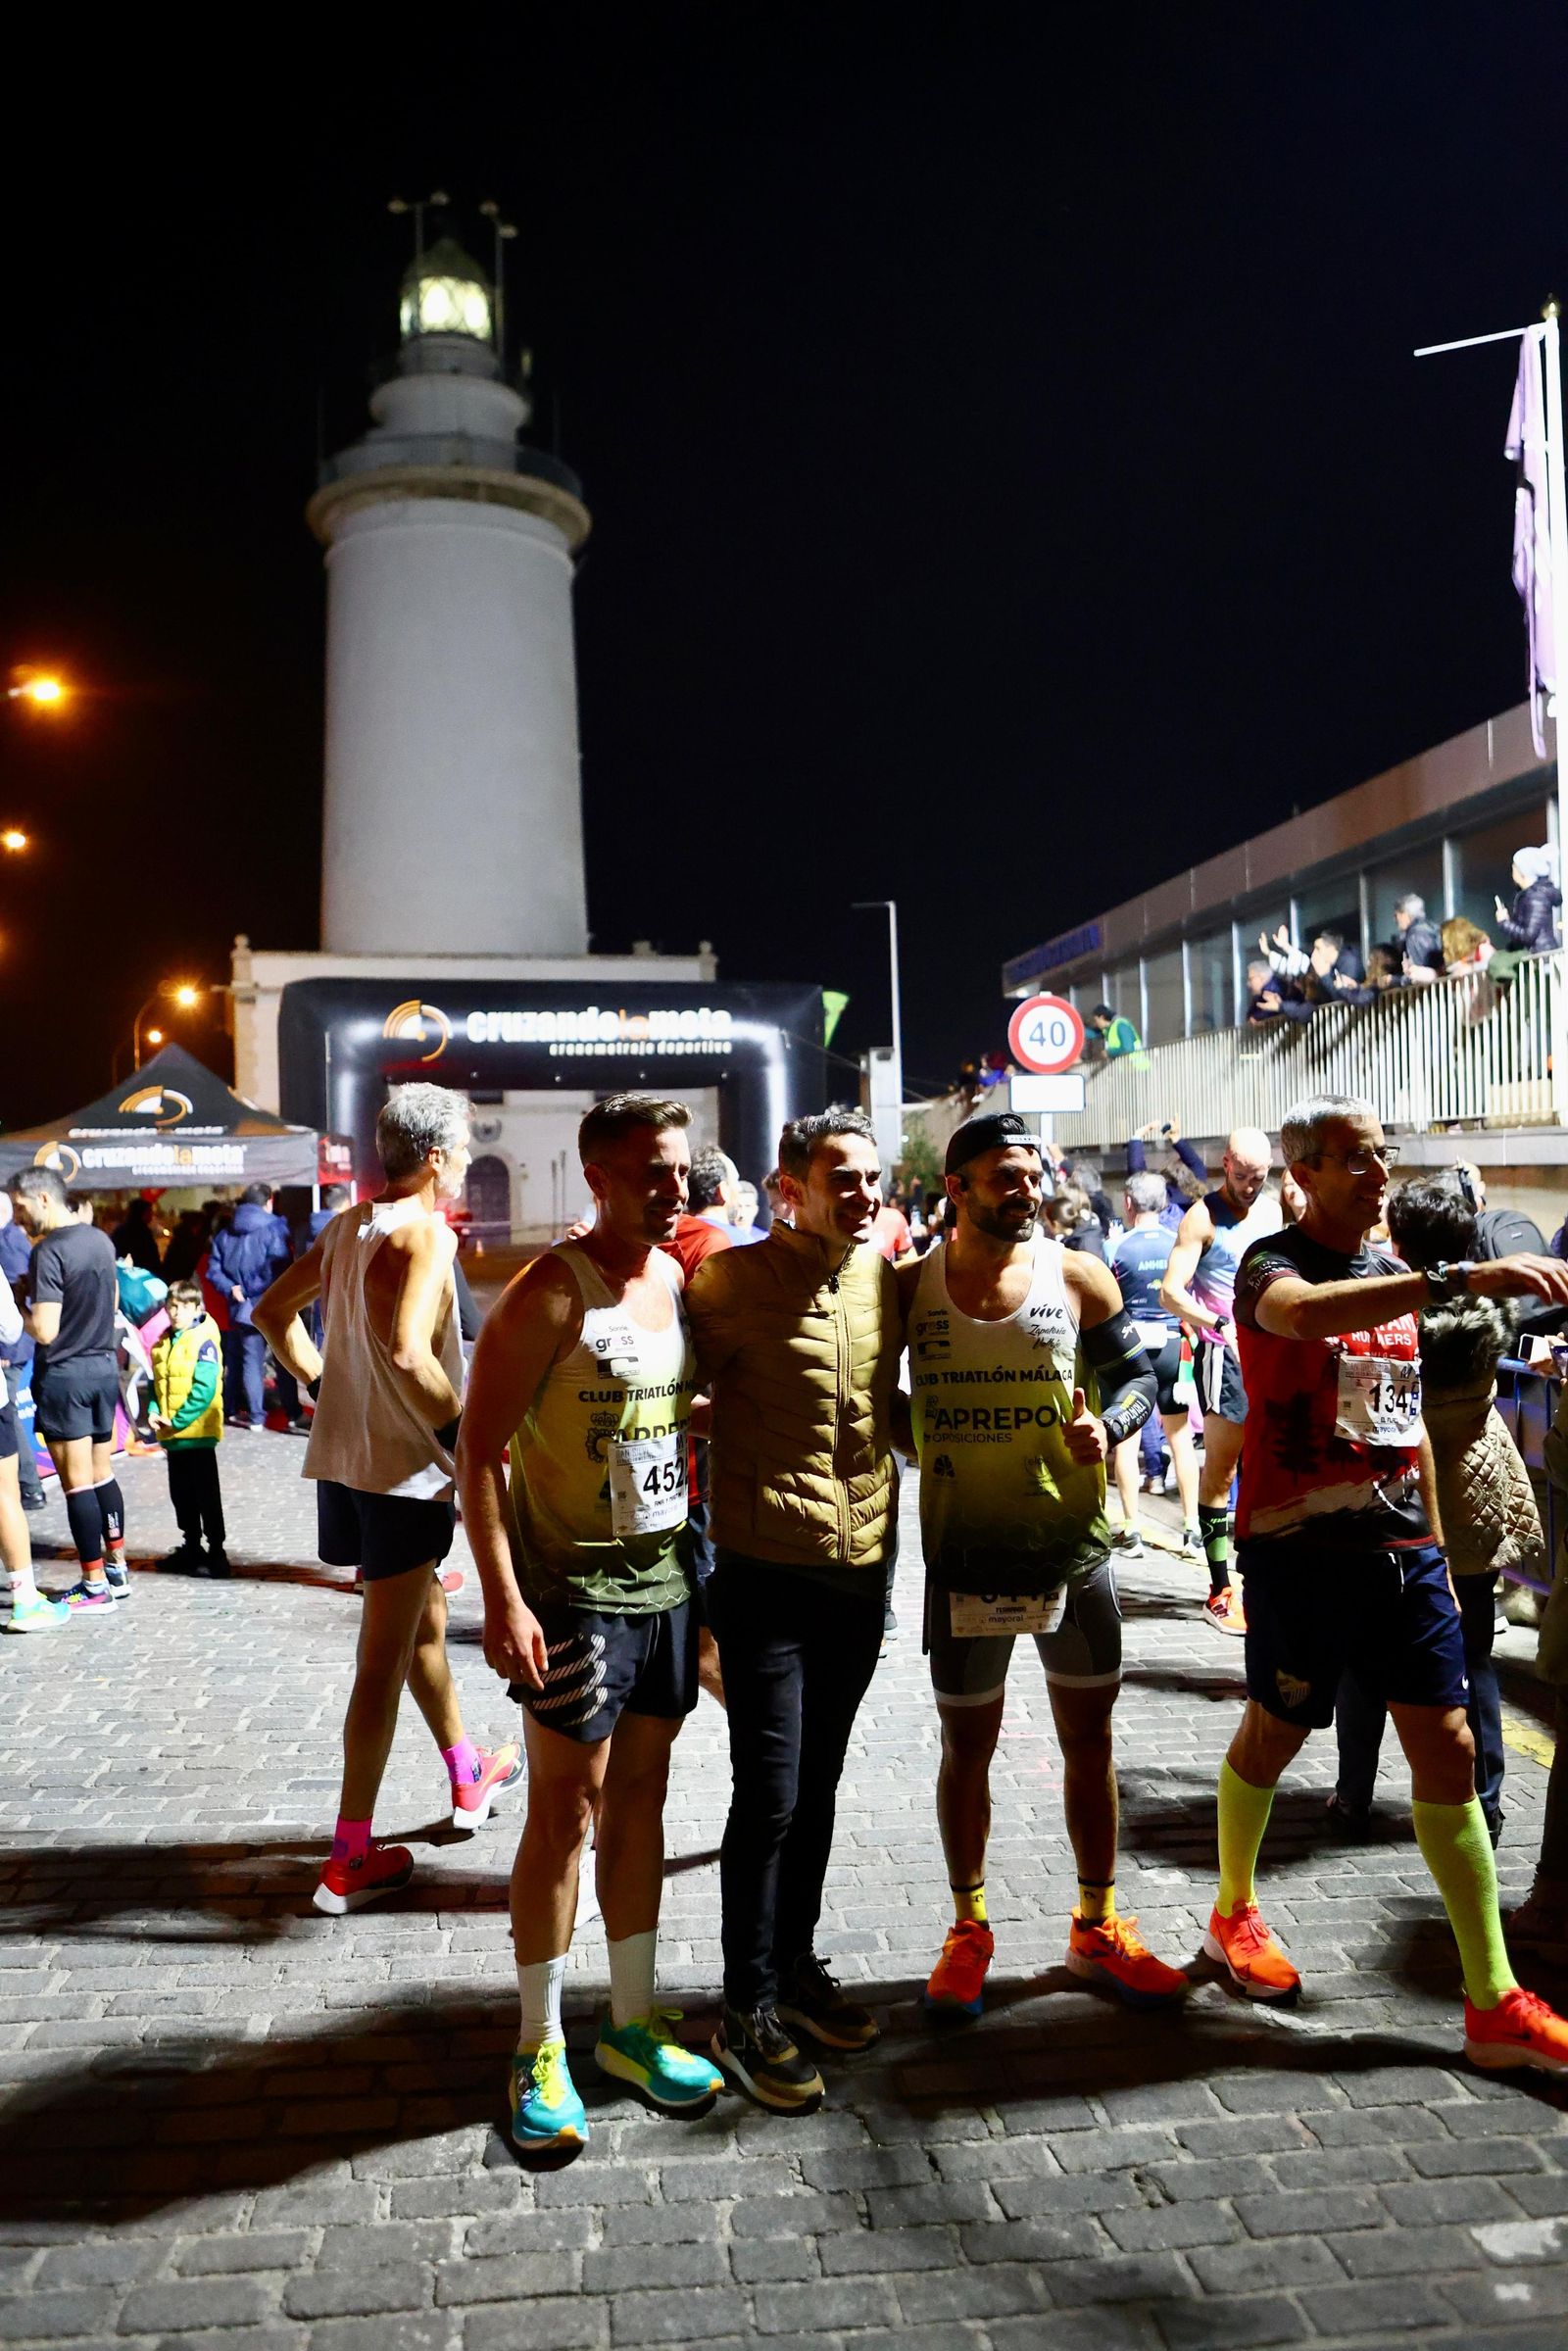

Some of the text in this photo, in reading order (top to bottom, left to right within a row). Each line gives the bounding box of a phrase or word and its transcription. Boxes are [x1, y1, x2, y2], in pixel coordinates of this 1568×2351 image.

[1028, 1020, 1066, 1047] 40
[915, 1363, 1073, 1386] CLUB TRIATLÓN MÁLAGA
[578, 1389, 624, 1403] CLUB
[626, 1378, 684, 1402] TRIATLÓN
[934, 1405, 1060, 1430] APREPO
[932, 1432, 1013, 1444] OPOSICIONES
